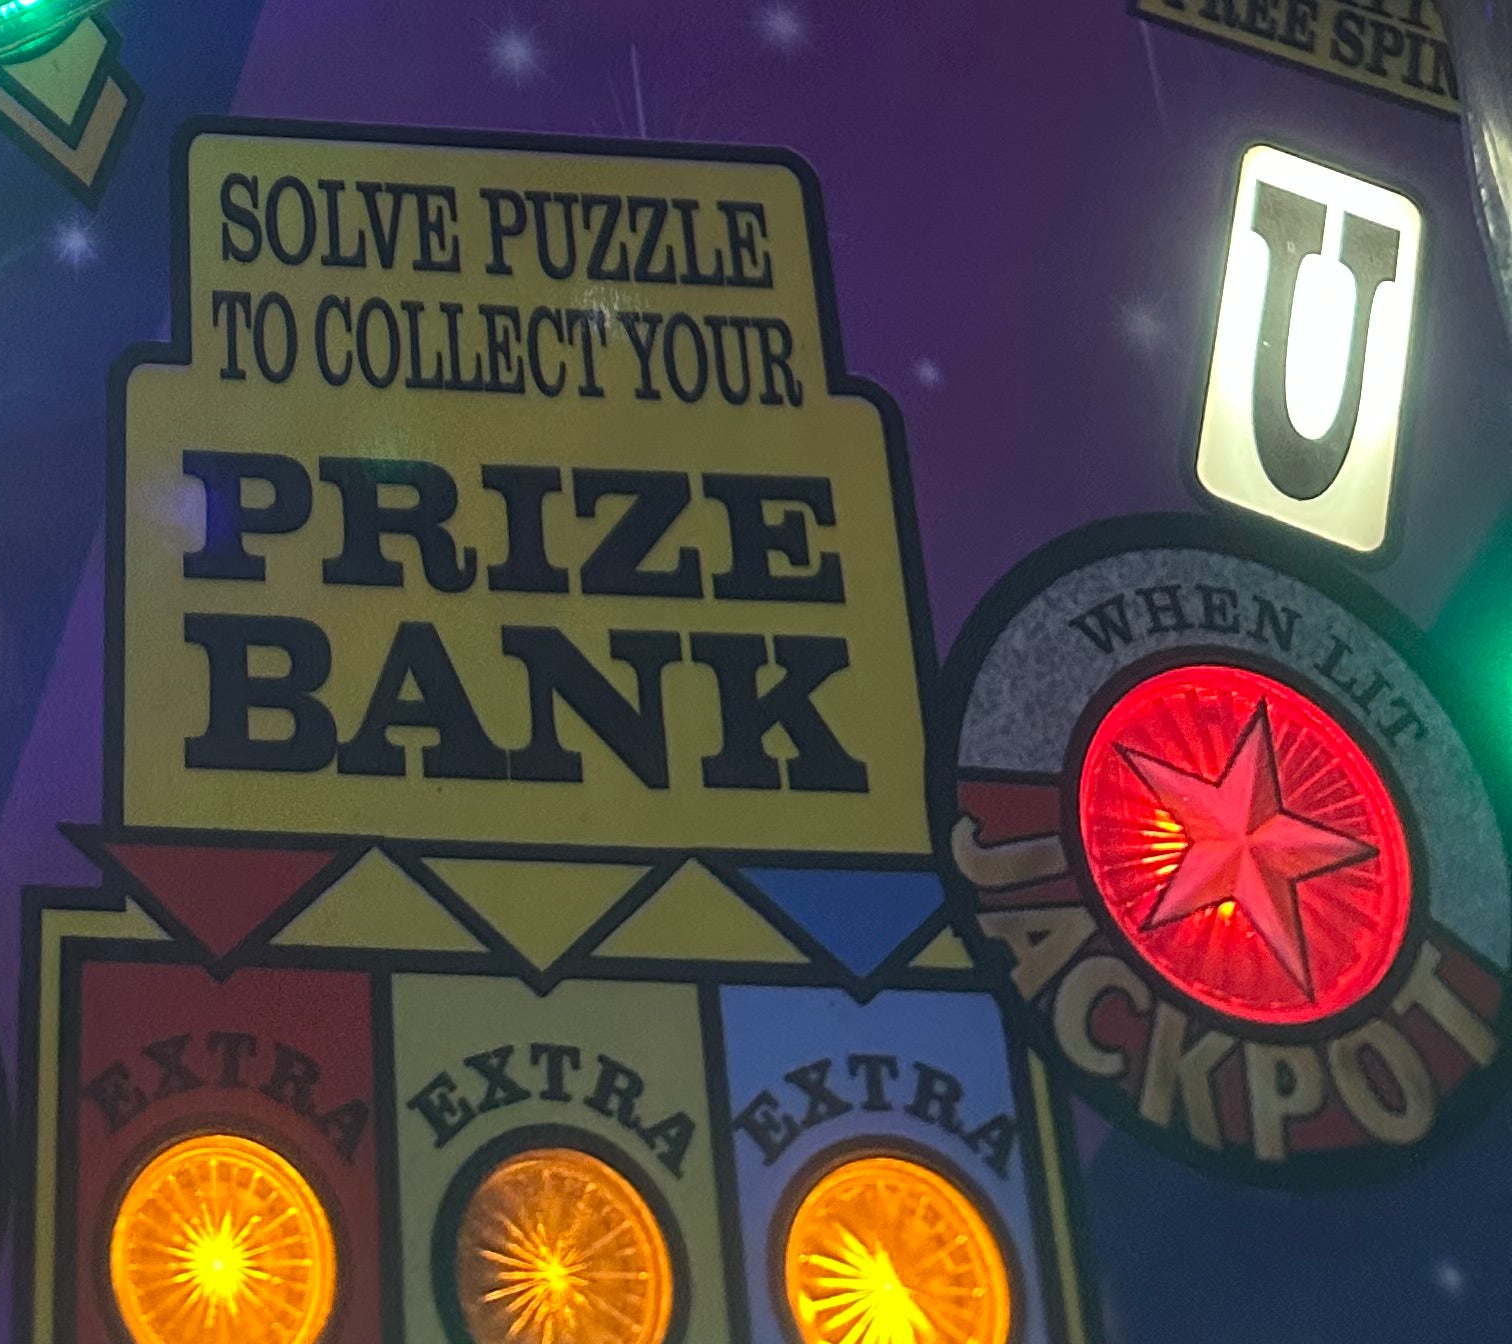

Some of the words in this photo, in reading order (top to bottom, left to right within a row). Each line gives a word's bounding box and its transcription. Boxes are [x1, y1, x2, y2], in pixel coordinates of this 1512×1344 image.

[221, 172, 461, 274] SOLVE
[481, 186, 774, 289] PUZZLE
[212, 290, 297, 383] TO
[315, 295, 608, 399] COLLECT
[629, 311, 804, 408] YOUR
[1250, 179, 1401, 501] U
[181, 449, 847, 605] PRIZE
[183, 612, 870, 794] BANK
[1069, 582, 1302, 655] WHEN
[1313, 632, 1428, 744] LIT
[951, 815, 1499, 1162] JACKPOT
[85, 1032, 373, 1166] EXTRA
[406, 1043, 699, 1180] EXTRA
[732, 1052, 1016, 1183] EXTRA
